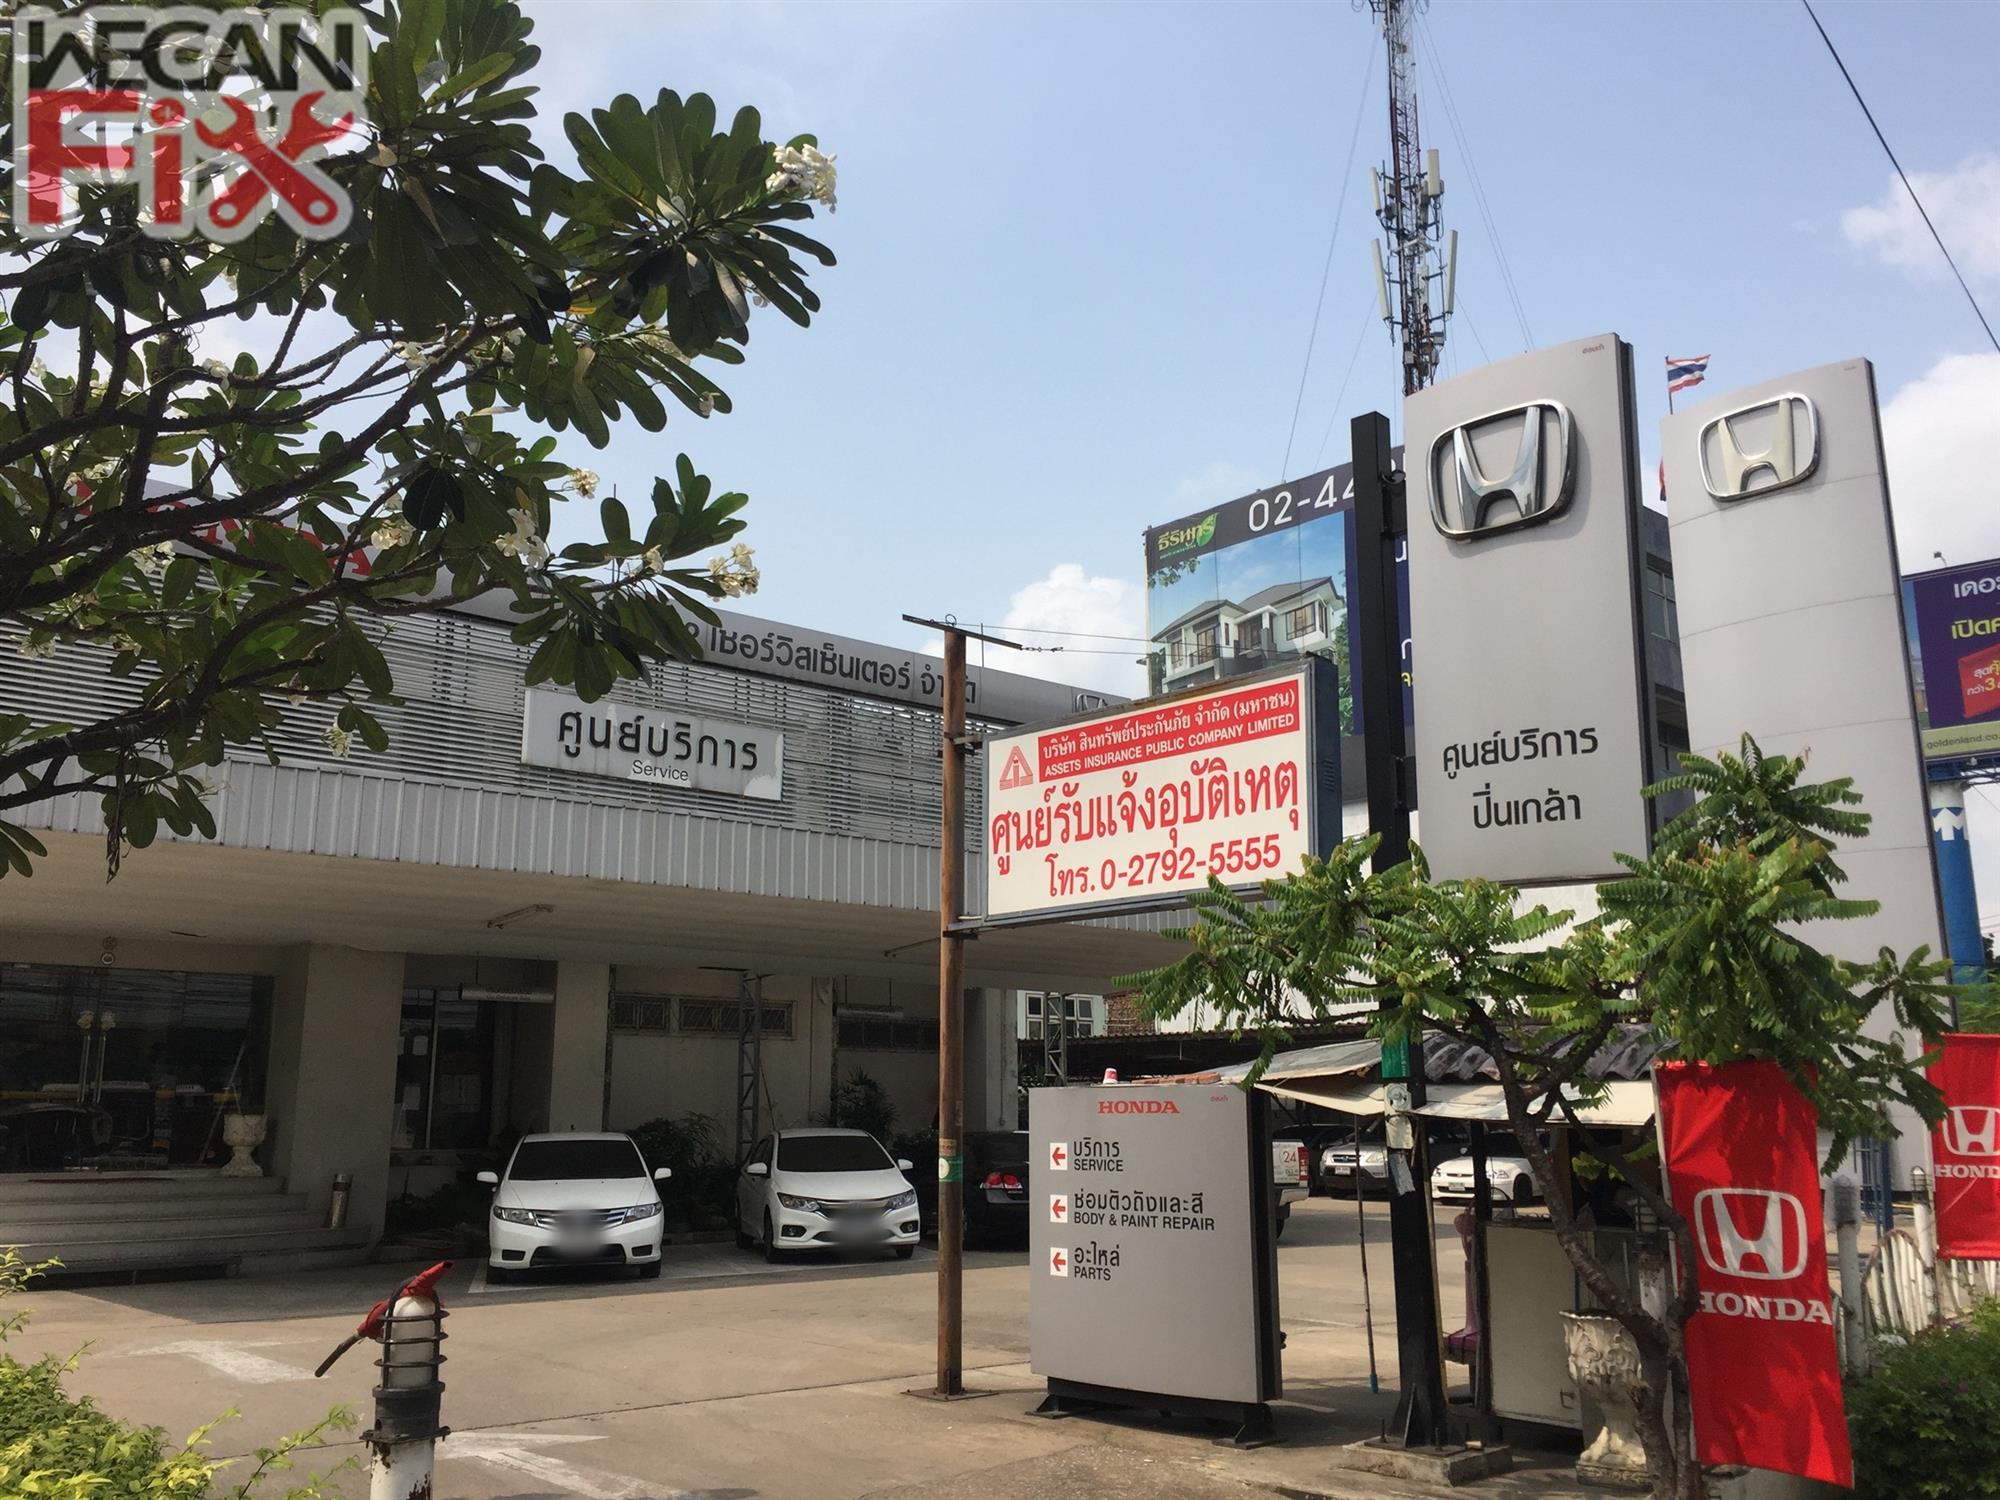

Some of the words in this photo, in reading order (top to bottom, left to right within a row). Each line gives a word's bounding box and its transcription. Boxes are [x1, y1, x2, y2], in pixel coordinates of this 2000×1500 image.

[1043, 736, 1077, 760] บริษัท
[1079, 710, 1191, 752] สินทรัพย์ประกันภัย
[1194, 702, 1230, 725] จำกัด
[1233, 689, 1296, 720] (มหาชน)
[557, 711, 759, 771] ศูนย์บริการ
[1044, 757, 1082, 777] ASSETS
[1084, 746, 1143, 769] INSURANCE
[1146, 737, 1185, 756] PUBLIC
[1188, 724, 1244, 748] COMPANY
[1247, 713, 1295, 735] LIMITED
[1442, 727, 1599, 780] ศูนย์บริการ
[632, 759, 690, 782] Service
[991, 757, 1300, 876] ศูนย์รับแจ้งอุบัติเหตุ
[1472, 782, 1582, 829] ปิ่นเกล้า
[1097, 1100, 1180, 1114] HONDA
[1074, 1137, 1121, 1157] บริการ
[1074, 1159, 1124, 1172] SERVICE
[1074, 1188, 1204, 1214] ซ่อมตัวถังและสี
[1074, 1212, 1105, 1225] BODY
[1109, 1214, 1118, 1226] &
[1121, 1215, 1158, 1229] PAINT
[1162, 1216, 1215, 1231] REPAIR
[1074, 1241, 1121, 1267] อะไหล่
[1074, 1266, 1112, 1281] PARTS
[1697, 1290, 1833, 1326] HONDA
